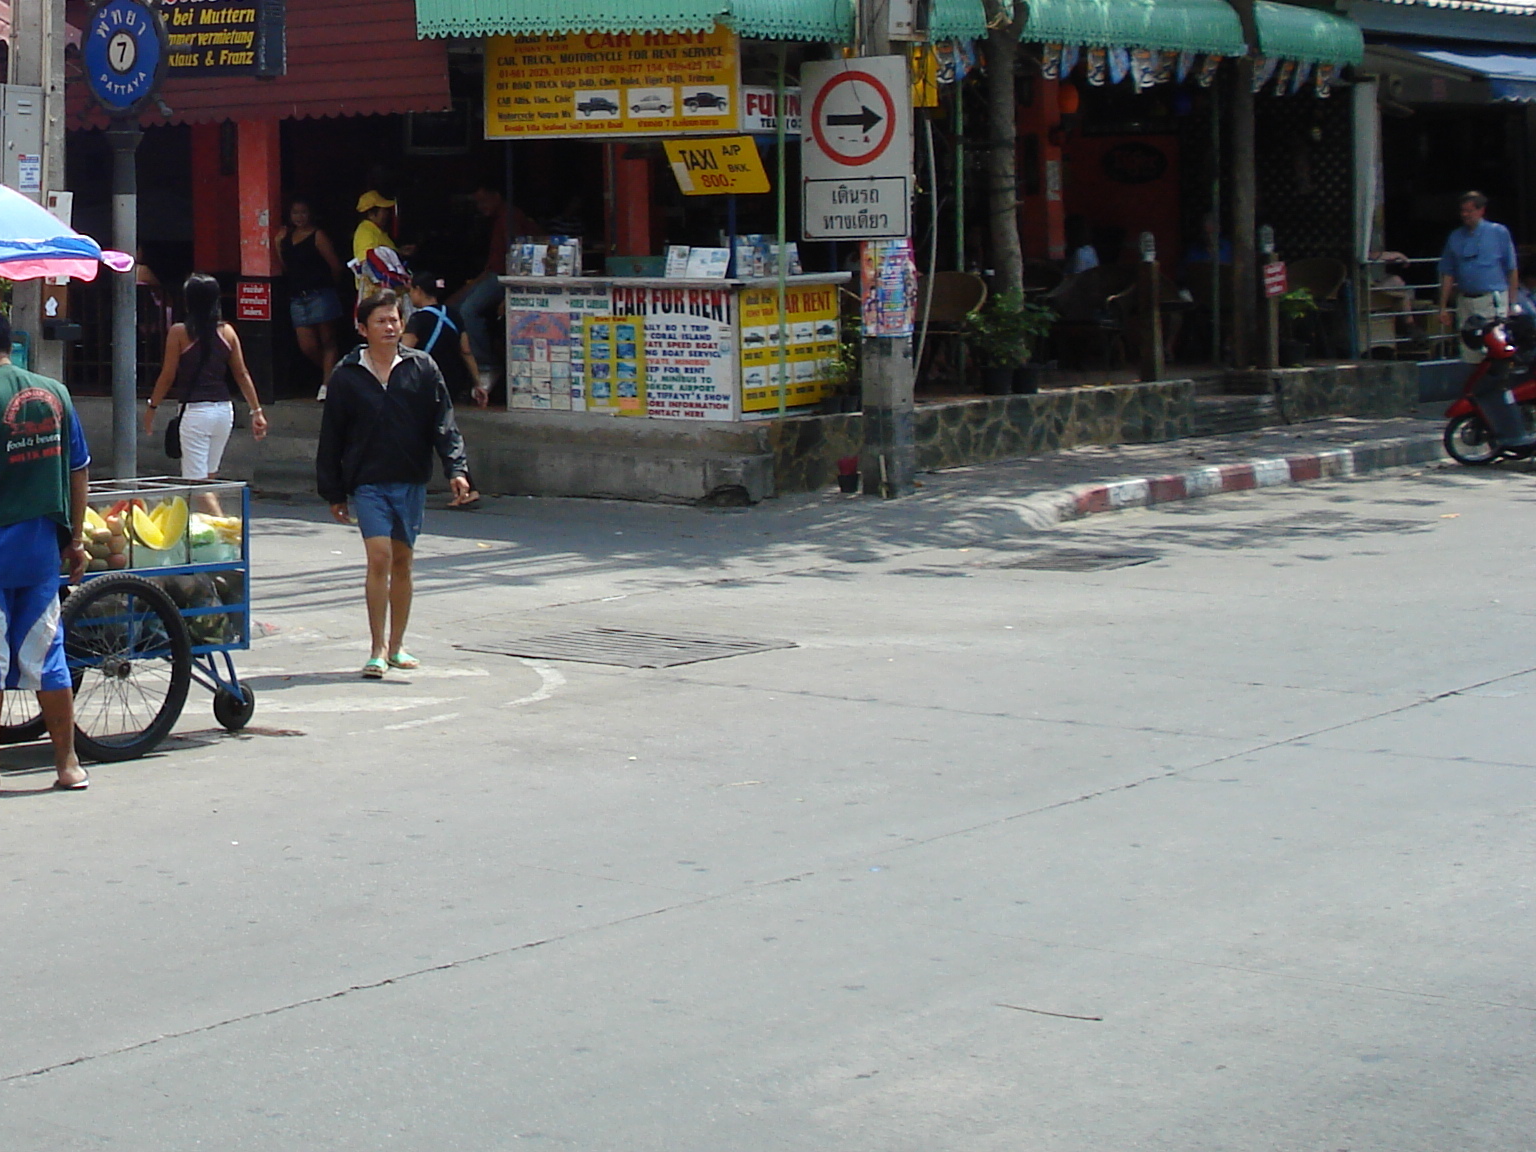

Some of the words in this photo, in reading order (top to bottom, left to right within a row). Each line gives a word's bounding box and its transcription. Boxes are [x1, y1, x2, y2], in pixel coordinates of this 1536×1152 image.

[173, 7, 195, 26] bei
[200, 8, 256, 25] Muttern
[117, 41, 126, 63] 7
[205, 50, 215, 66] &
[219, 49, 254, 66] Franz
[560, 50, 622, 64] MOTORCYCLE
[628, 49, 648, 60] FOR
[653, 48, 677, 59] RENT
[682, 46, 724, 59] SERVICE
[100, 71, 146, 96] PATTAYA
[679, 149, 719, 171] TAXI
[722, 144, 741, 156] A/P
[832, 184, 879, 205] เดินรถ
[824, 208, 888, 229] ทางเดียว
[613, 288, 646, 316] CAR
[651, 288, 685, 315] FOR
[688, 289, 731, 326] RENT
[802, 291, 831, 313] RENT
[664, 349, 684, 357] BOAT
[668, 401, 729, 410] INFORMATION
[704, 393, 731, 401] SHOW
[7, 437, 26, 452] food
